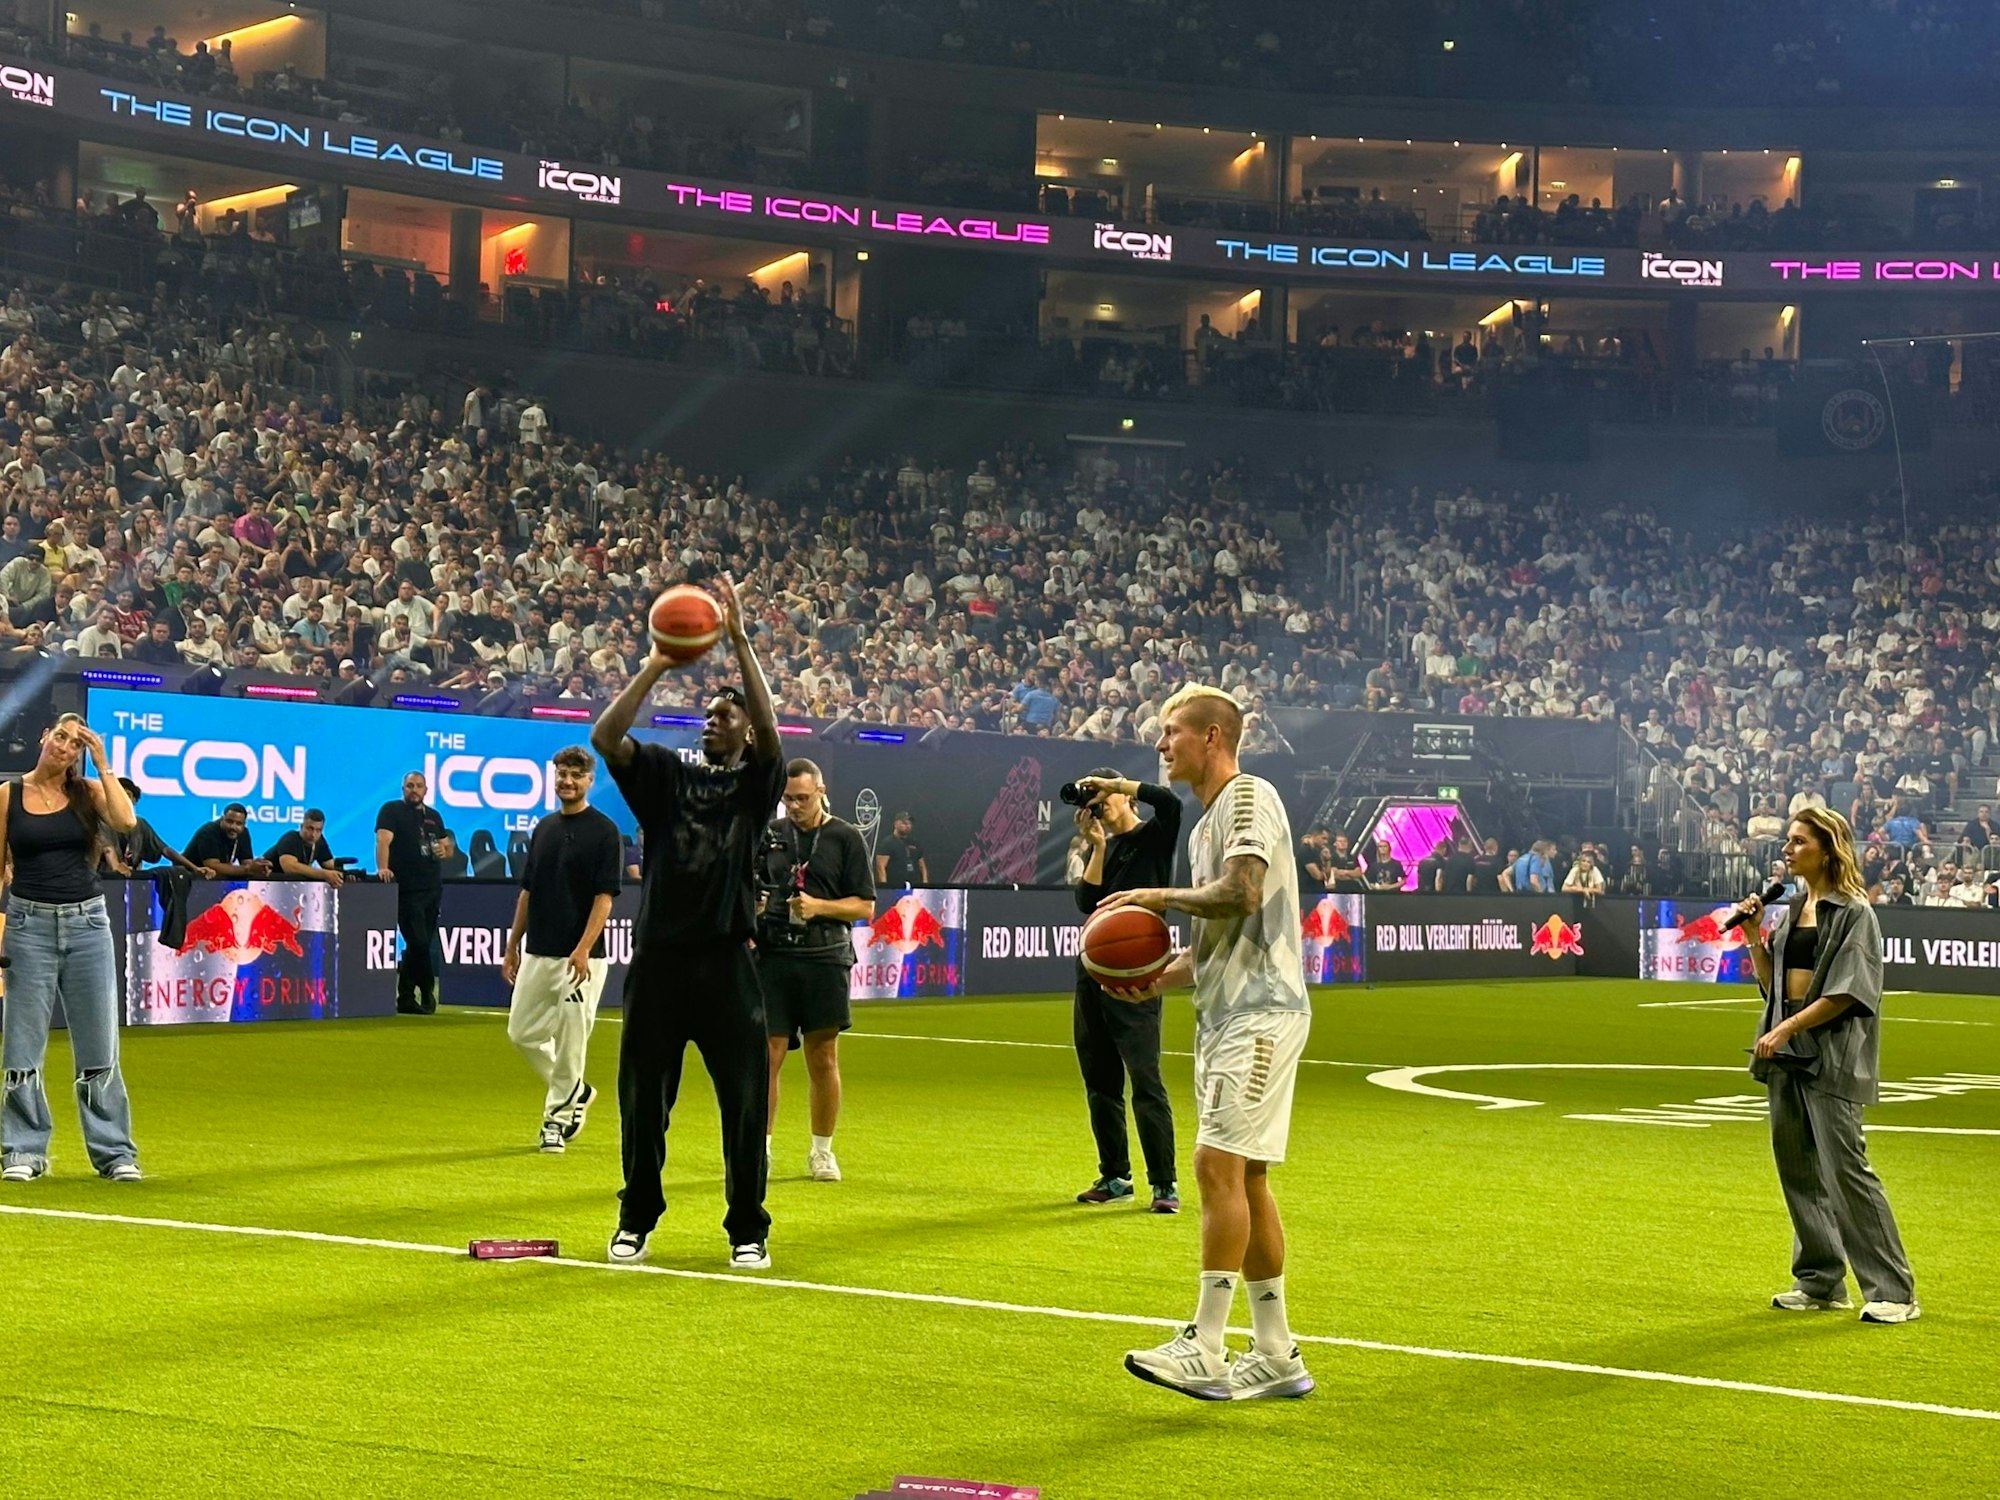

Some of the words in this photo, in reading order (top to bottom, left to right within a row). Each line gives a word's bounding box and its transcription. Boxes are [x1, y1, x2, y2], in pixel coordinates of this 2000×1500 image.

[0, 64, 54, 98] ON
[12, 90, 53, 106] LEAGUE
[100, 89, 191, 126] THE
[206, 110, 309, 147] ICON
[322, 131, 504, 180] LEAGUE
[538, 160, 560, 170] THE
[538, 167, 621, 197] ICON
[578, 192, 620, 204] LEAGUE
[666, 184, 752, 212] THE
[765, 197, 859, 226] ICON
[871, 210, 1049, 244] LEAGUE
[1095, 222, 1115, 231] THE
[1094, 229, 1172, 253] ICON
[1132, 251, 1171, 261] LEAGUE
[1216, 240, 1298, 263] THE
[1311, 247, 1409, 268] ICON
[1422, 252, 1604, 276] LEAGUE
[1642, 252, 1663, 260] THE
[1641, 258, 1723, 279] ICON
[1770, 262, 1861, 279] THE
[1875, 262, 1979, 279] ICON
[1681, 278, 1722, 286] LEAGUE
[113, 711, 163, 731] THE
[425, 732, 465, 749] THE
[112, 735, 306, 800] ICON
[212, 803, 304, 823] LAGUE
[504, 814, 541, 831] LEA
[366, 929, 400, 970] RE
[438, 926, 512, 966] VERL
[982, 926, 1011, 959] RED
[1014, 926, 1049, 958] BULL
[1052, 926, 1084, 957] VER
[1376, 925, 1397, 951] RED
[1399, 925, 1424, 951] BULL
[1425, 925, 1471, 950] VERLEIHT
[1880, 937, 1917, 965] ULL
[1922, 939, 2000, 968] VERLEI
[851, 963, 911, 988] NERGY
[1651, 955, 1732, 975] ENERGY
[142, 977, 249, 1010] ENERGY
[260, 976, 327, 1005] DRINK
